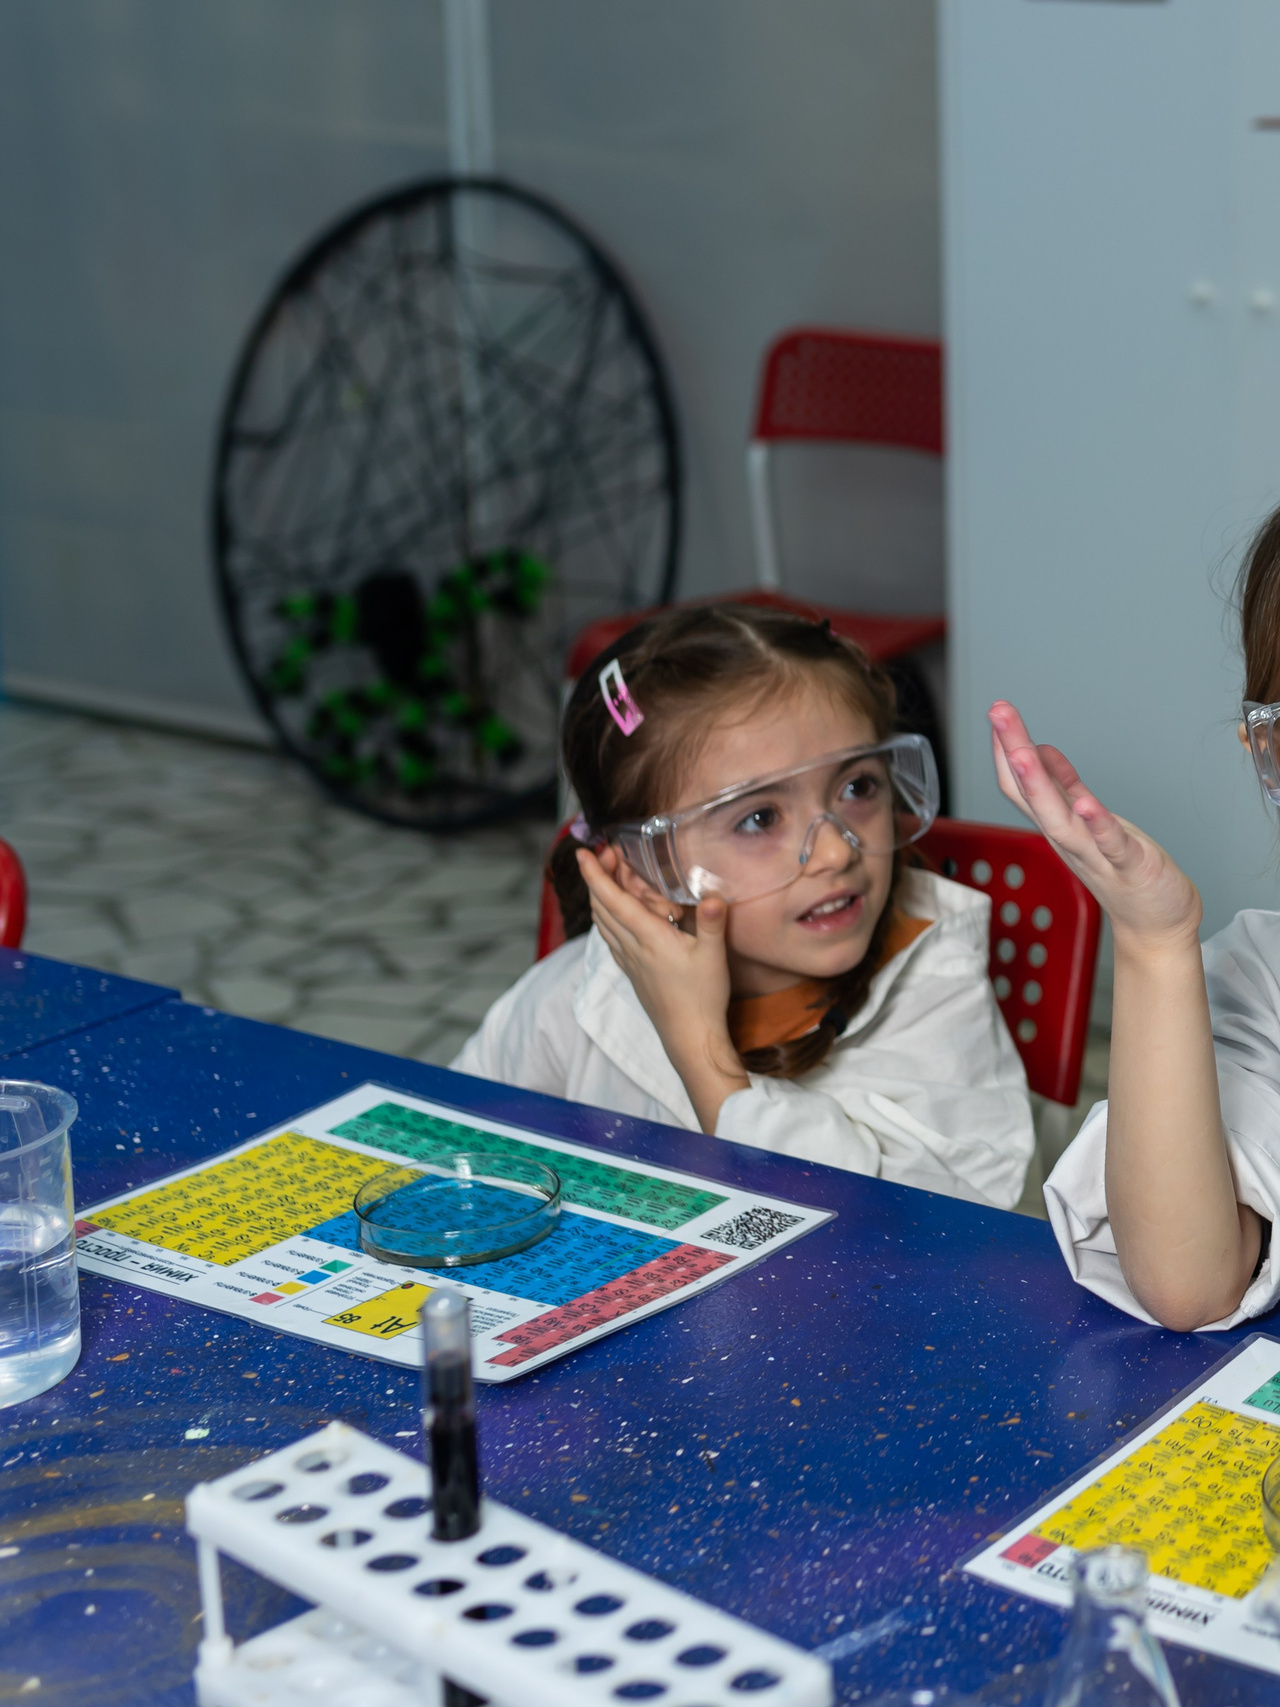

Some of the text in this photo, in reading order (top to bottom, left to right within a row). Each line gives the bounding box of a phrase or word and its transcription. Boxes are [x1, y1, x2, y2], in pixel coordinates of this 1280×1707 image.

[333, 1313, 362, 1324] 85
[370, 1315, 418, 1334] At
[1191, 1416, 1212, 1429] Og
[1228, 1429, 1244, 1439] Ts
[1165, 1439, 1187, 1451] Rn
[1262, 1439, 1279, 1450] Lv
[1137, 1462, 1158, 1474] Xe
[1233, 1461, 1253, 1472] Po
[1207, 1483, 1224, 1494] Te
[1240, 1493, 1260, 1504] Sb
